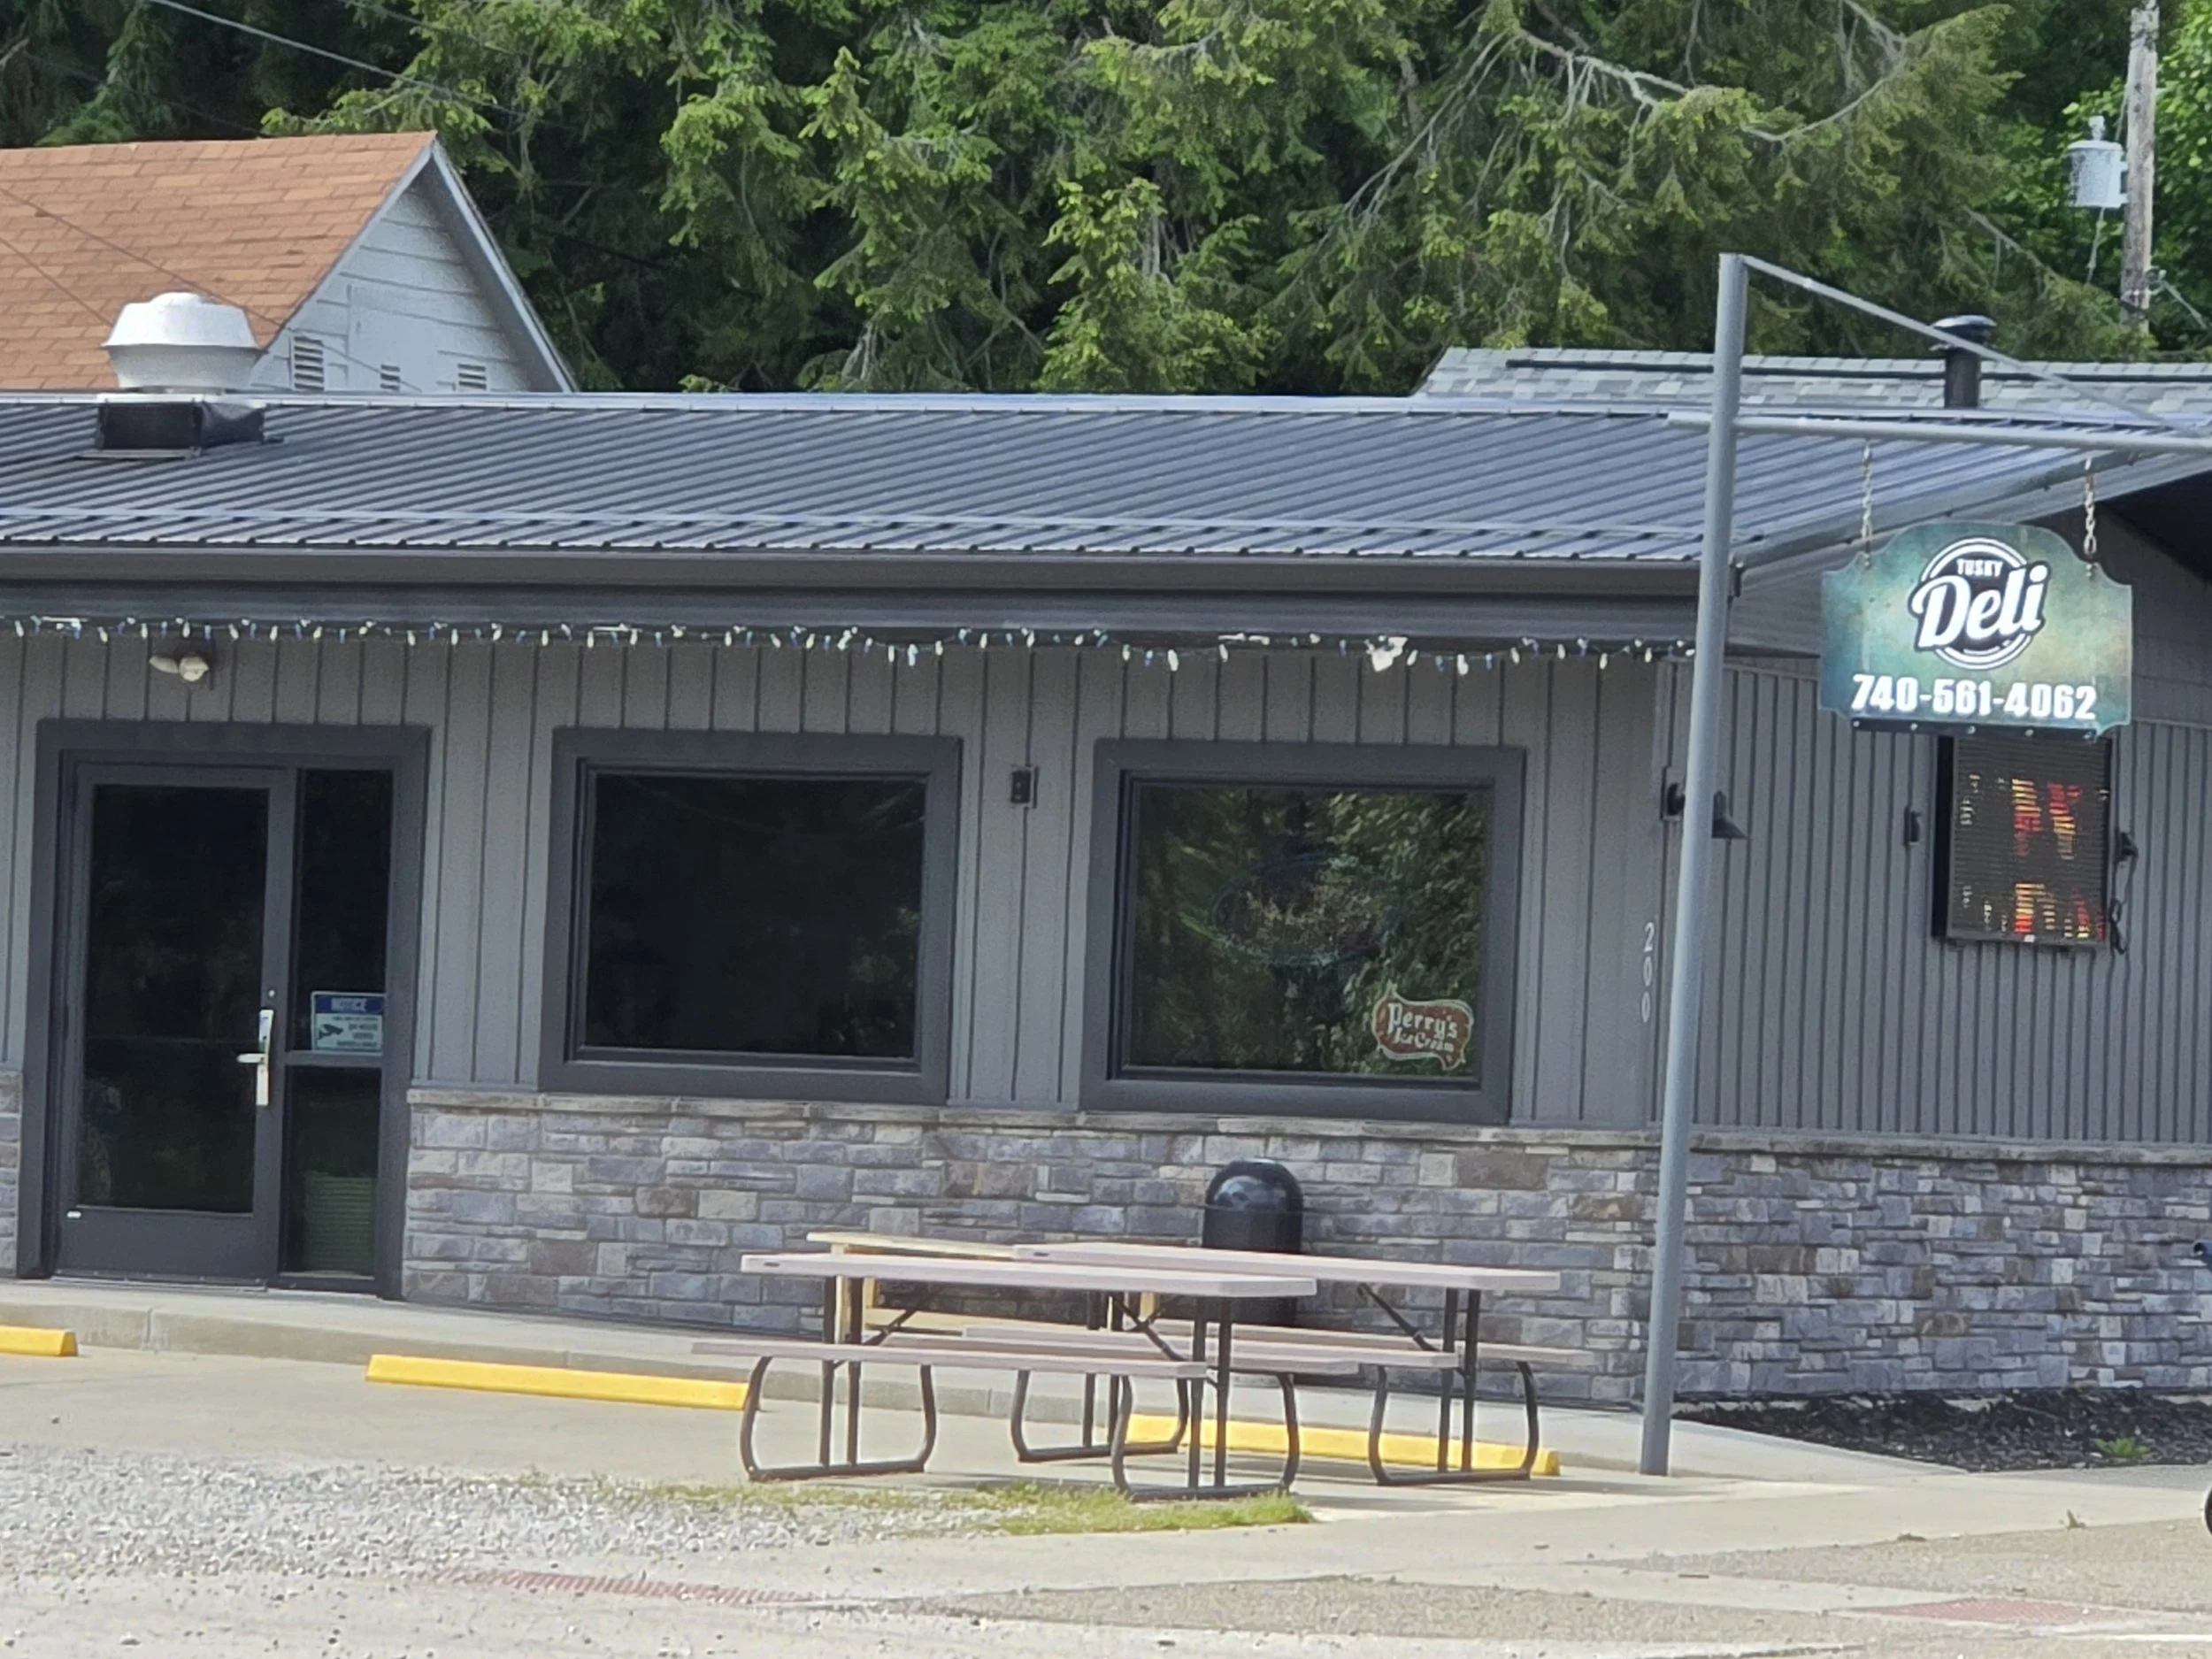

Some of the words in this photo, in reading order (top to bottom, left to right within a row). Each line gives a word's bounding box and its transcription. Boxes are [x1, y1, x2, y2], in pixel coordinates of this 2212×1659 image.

[1956, 558, 2003, 578] TUSKY
[1912, 564, 2048, 648] Deli
[1851, 674, 2097, 720] 740-561-4062
[1386, 1002, 1458, 1040] Perry's
